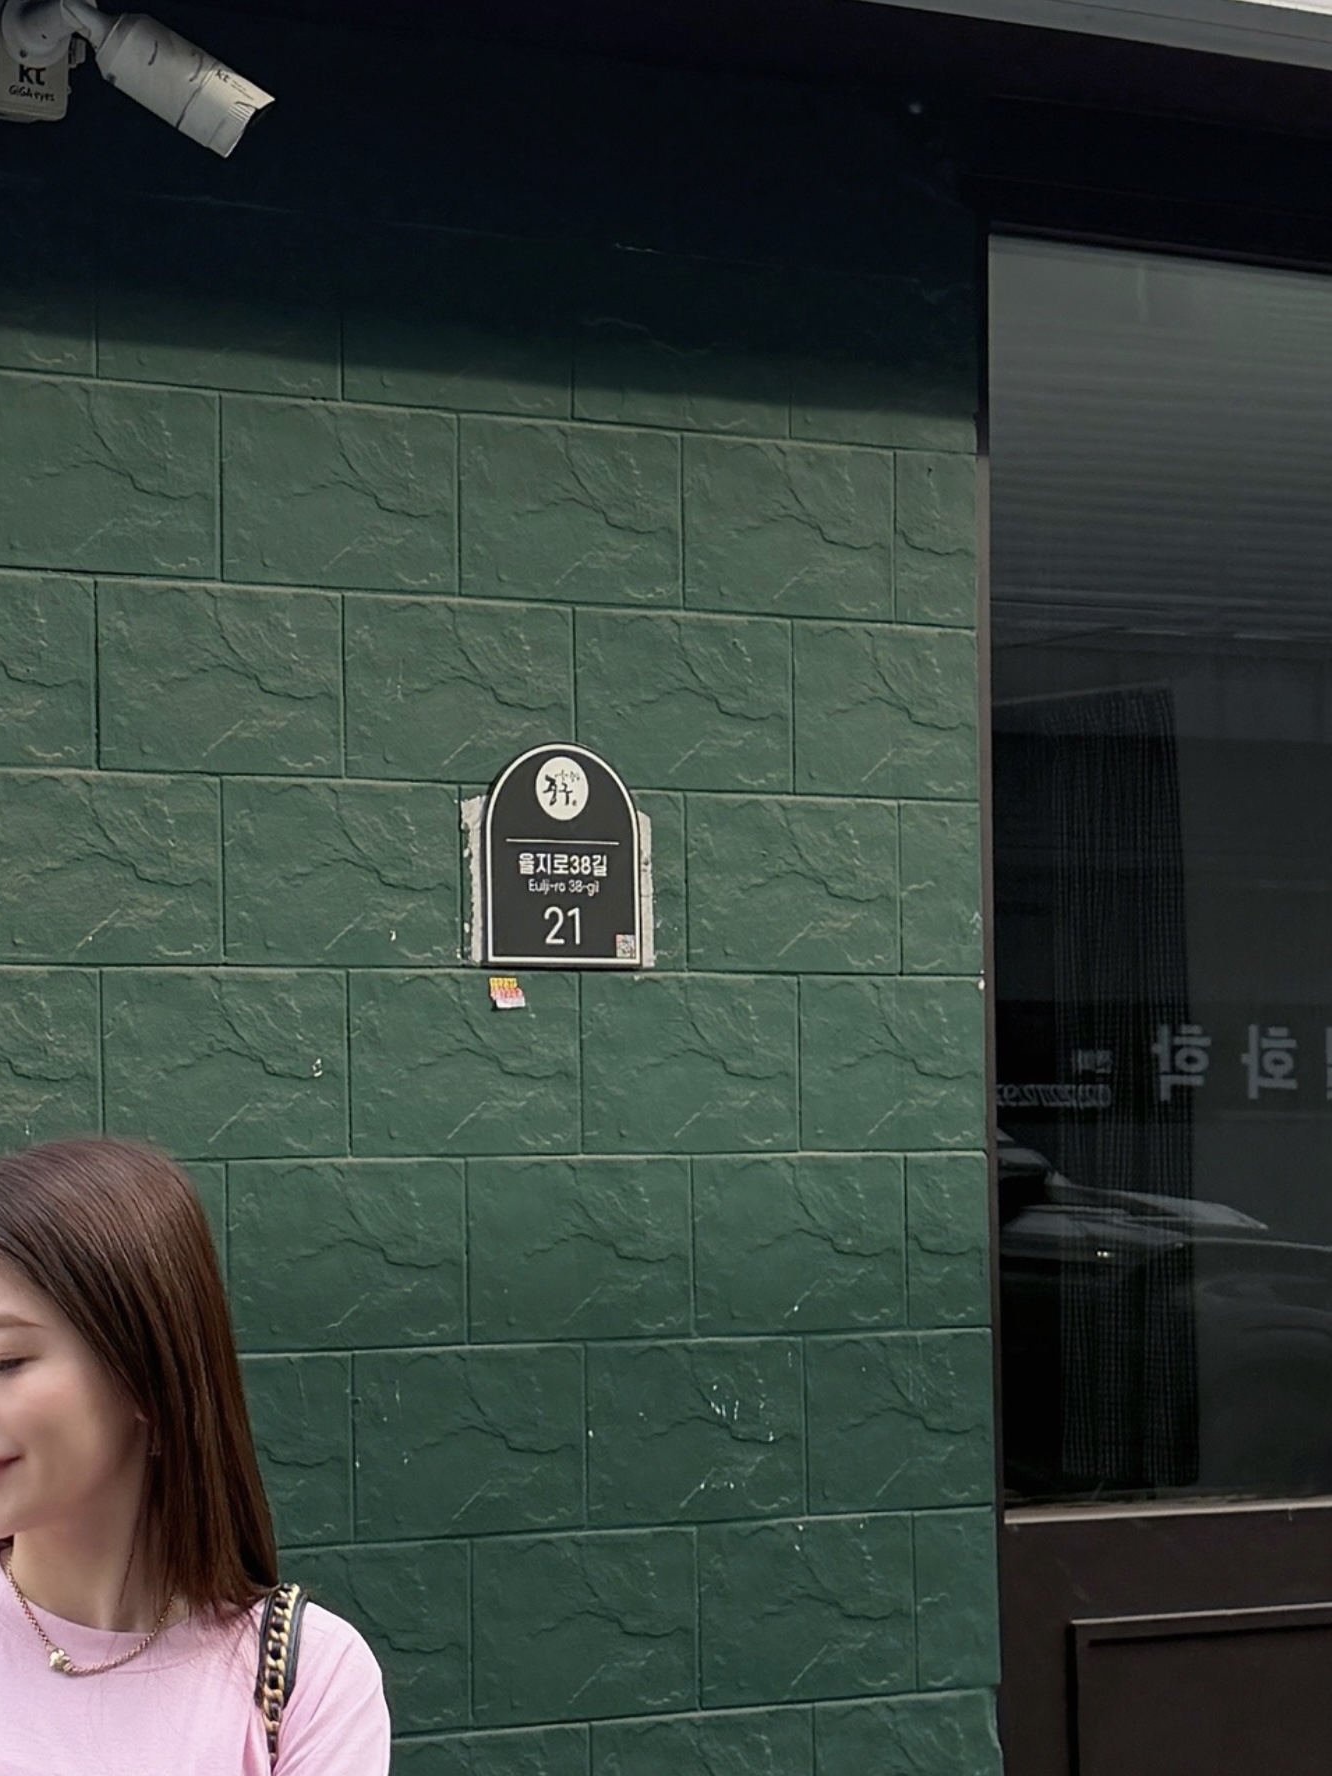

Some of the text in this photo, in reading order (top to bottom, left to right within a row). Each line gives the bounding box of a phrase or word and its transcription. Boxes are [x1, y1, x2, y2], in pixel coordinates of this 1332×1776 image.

[519, 853, 607, 877] 을지로38길
[528, 879, 566, 895] Eulji-ro
[544, 906, 580, 945] 21
